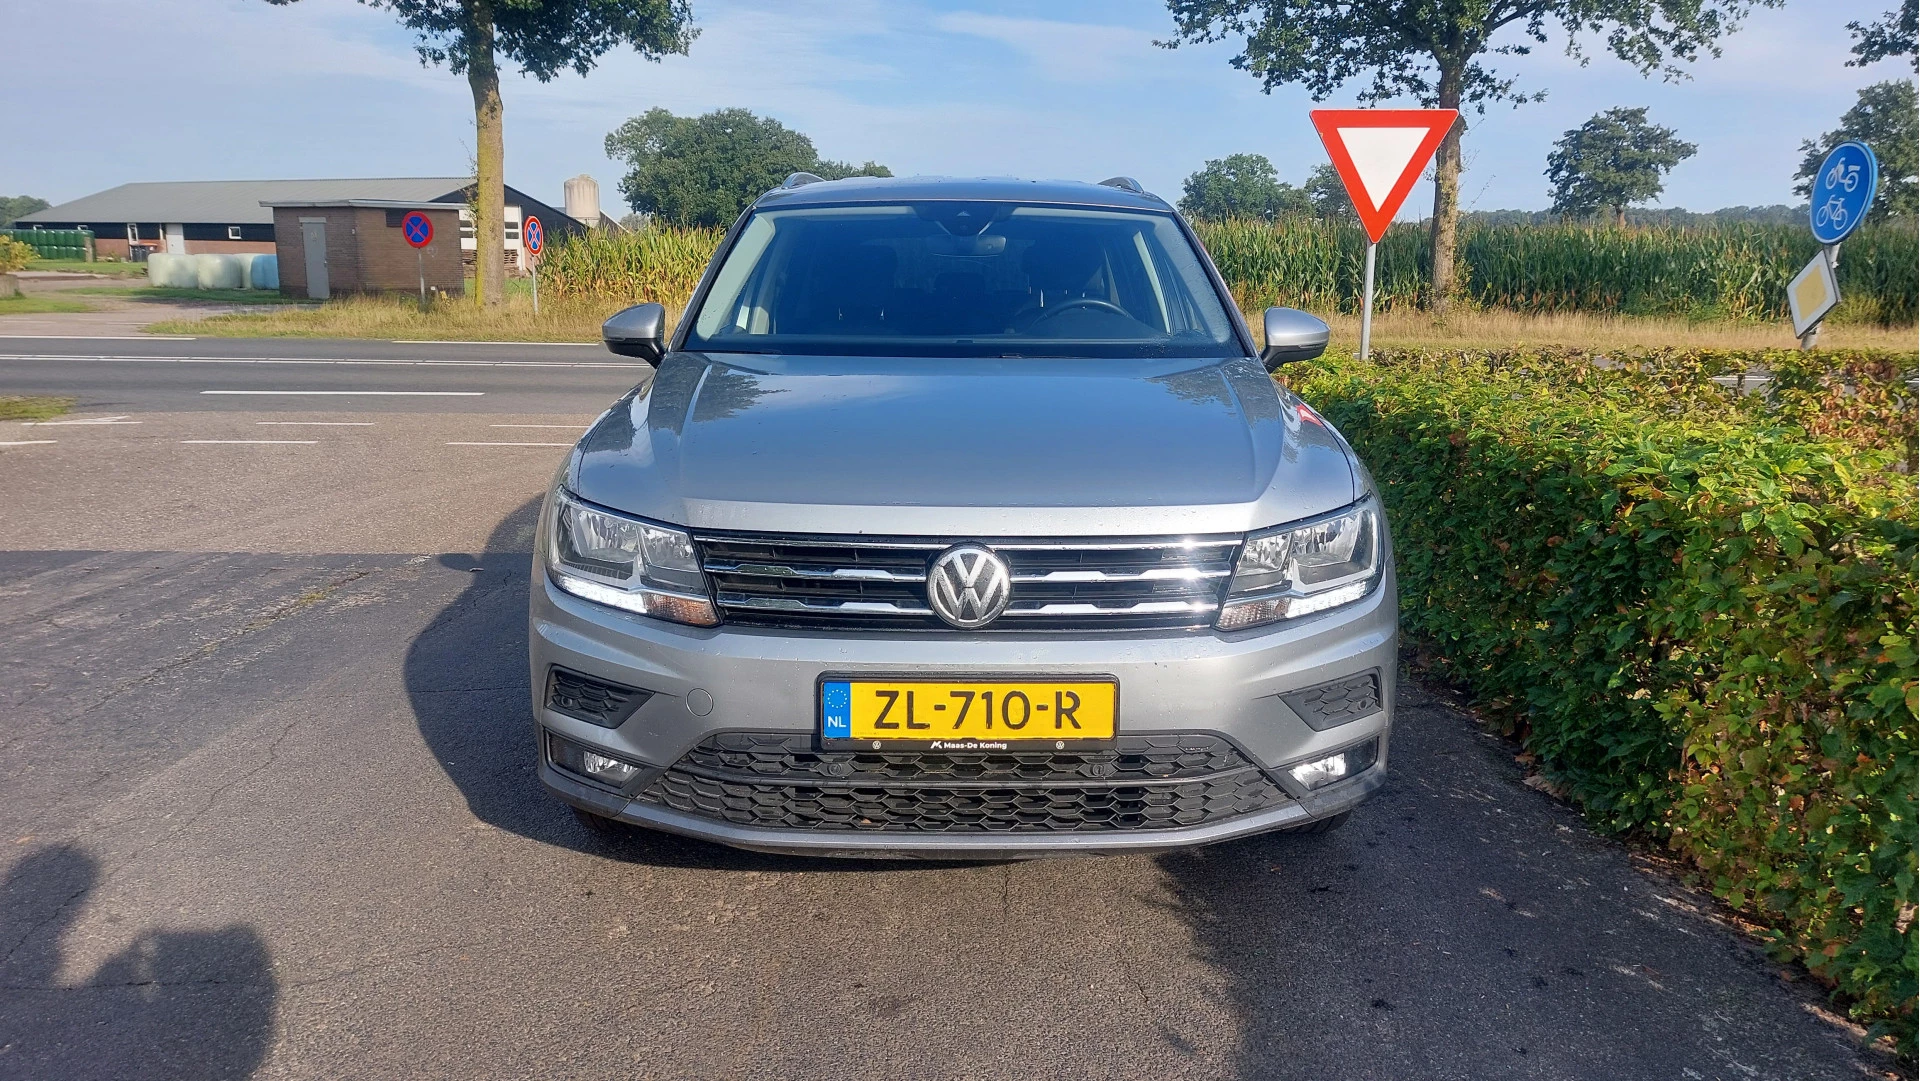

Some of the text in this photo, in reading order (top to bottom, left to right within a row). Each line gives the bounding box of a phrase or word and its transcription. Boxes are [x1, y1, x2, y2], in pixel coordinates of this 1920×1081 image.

[874, 690, 1082, 730] ZL-710-R
[827, 715, 847, 728] NL
[944, 741, 1008, 751] Maas-De Koning
